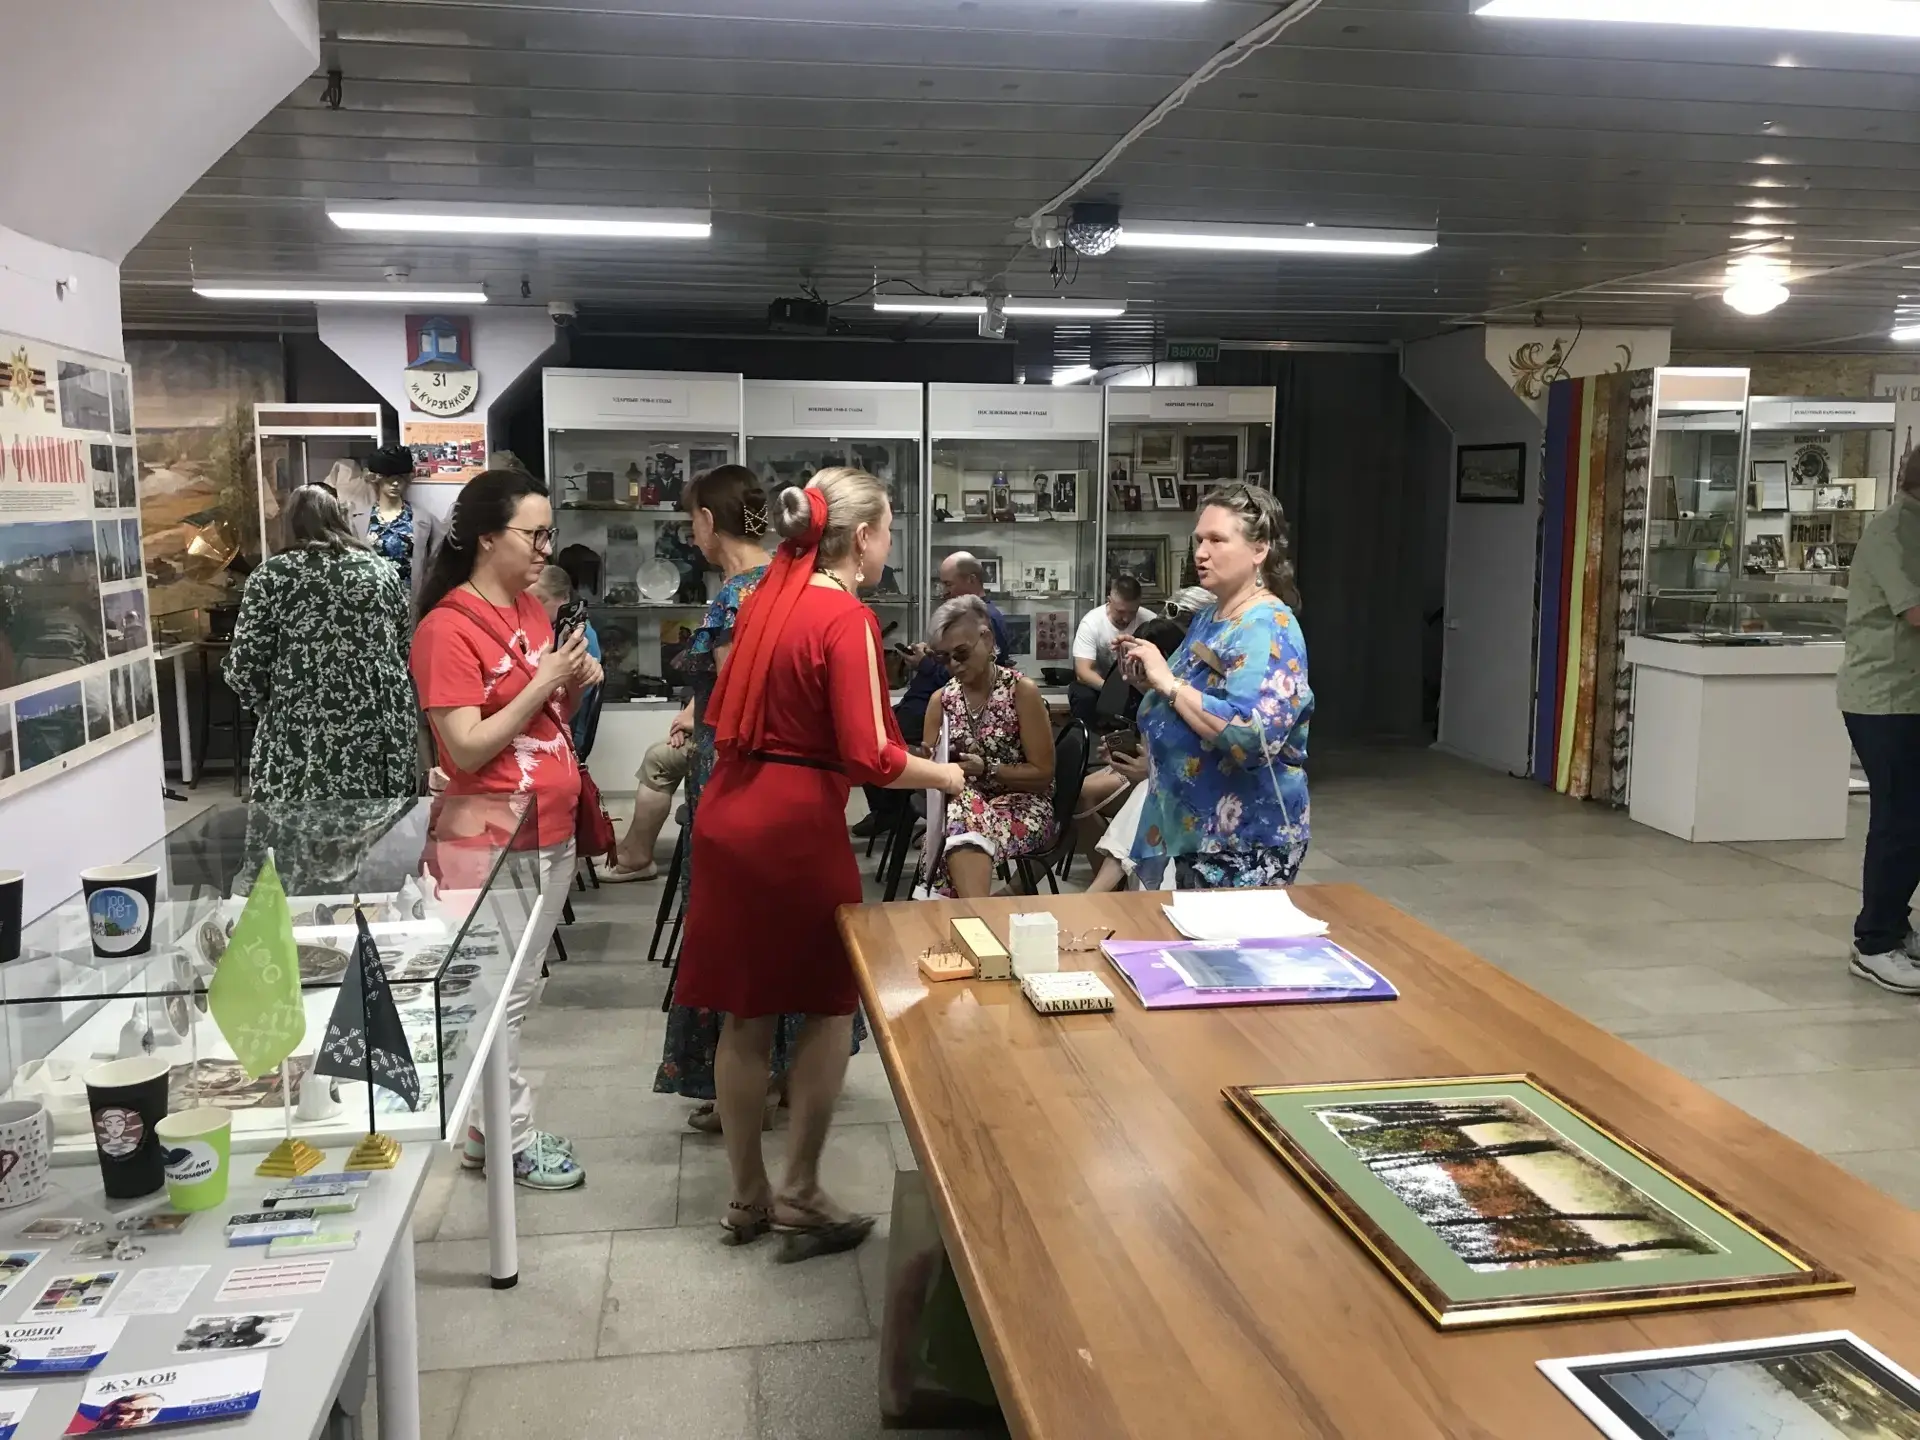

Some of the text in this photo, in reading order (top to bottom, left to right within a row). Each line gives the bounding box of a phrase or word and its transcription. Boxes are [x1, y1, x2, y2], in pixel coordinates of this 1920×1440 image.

[1171, 346, 1215, 360] ВЫХОД
[433, 373, 447, 387] 31
[1043, 998, 1112, 1012] АКВАРЕЛЬ
[99, 1371, 177, 1392] ЖУКОВ
